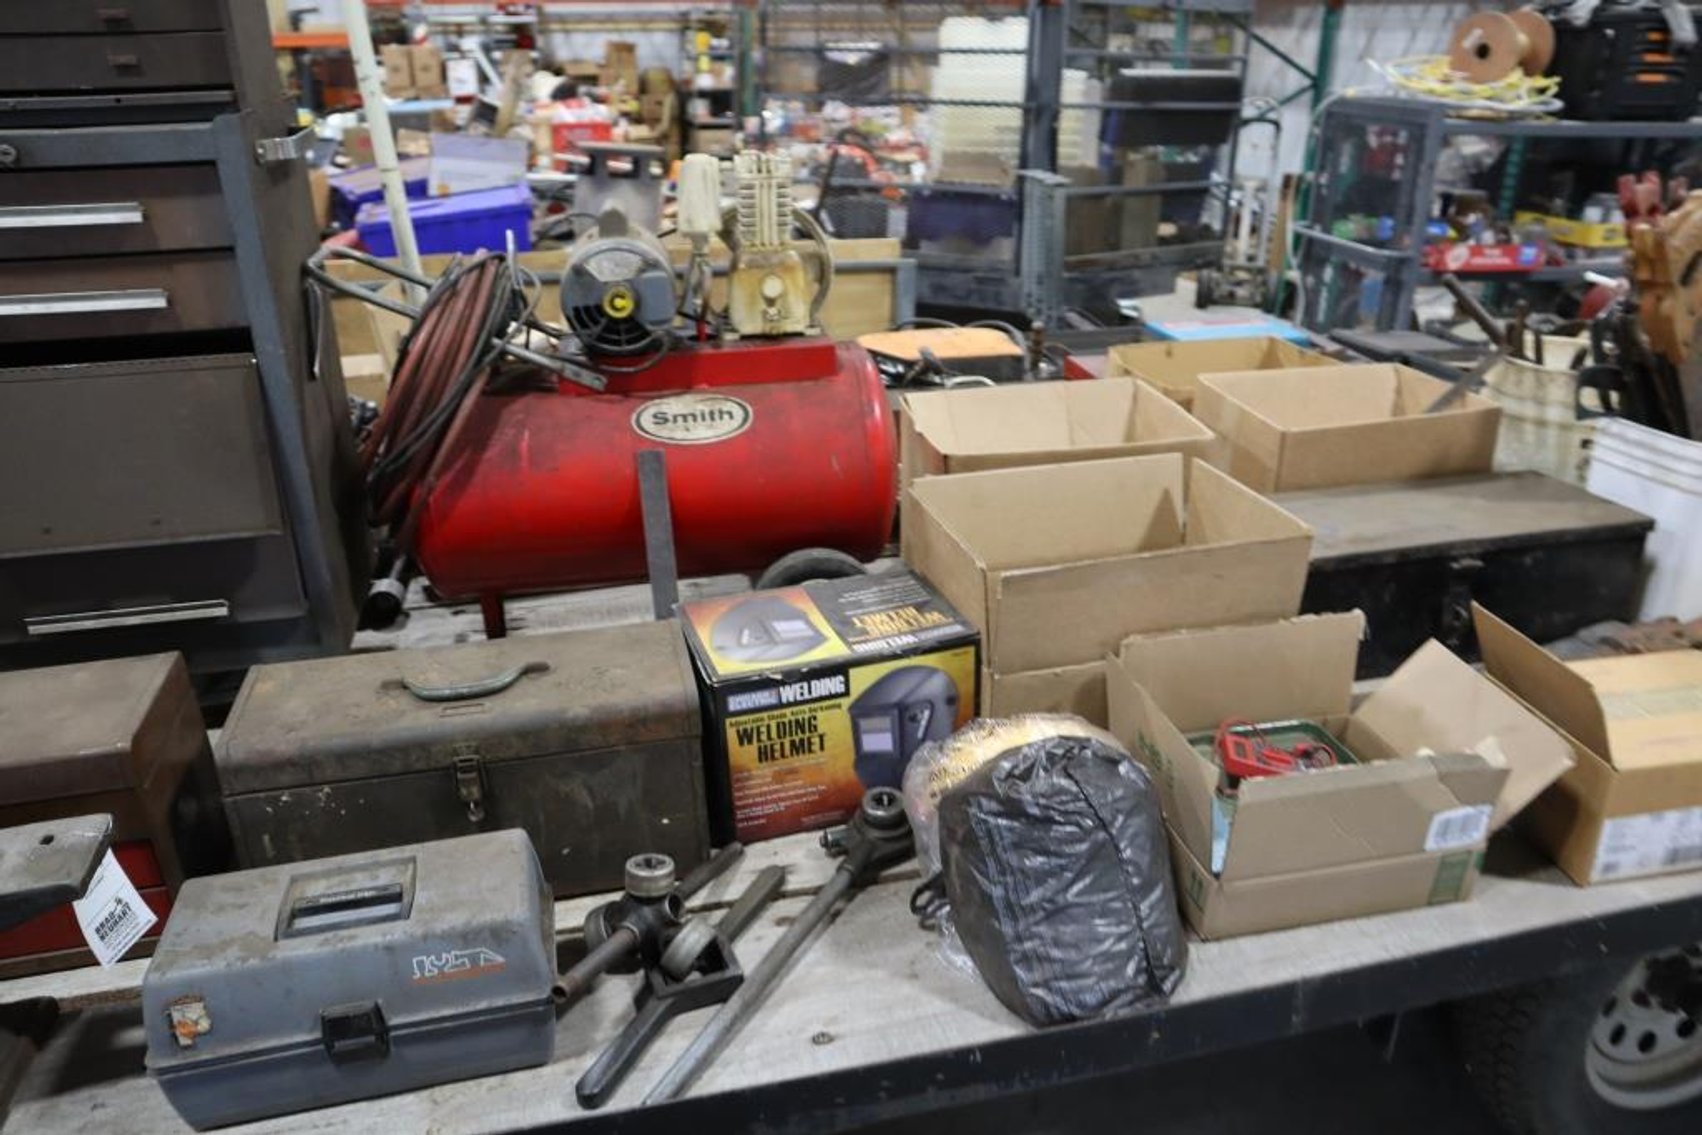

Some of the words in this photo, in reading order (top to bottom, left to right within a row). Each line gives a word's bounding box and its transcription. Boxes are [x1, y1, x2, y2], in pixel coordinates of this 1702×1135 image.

[652, 407, 734, 425] Smith
[780, 675, 846, 704] WELDING
[736, 714, 818, 747] WELDING
[757, 732, 826, 764] HELMET
